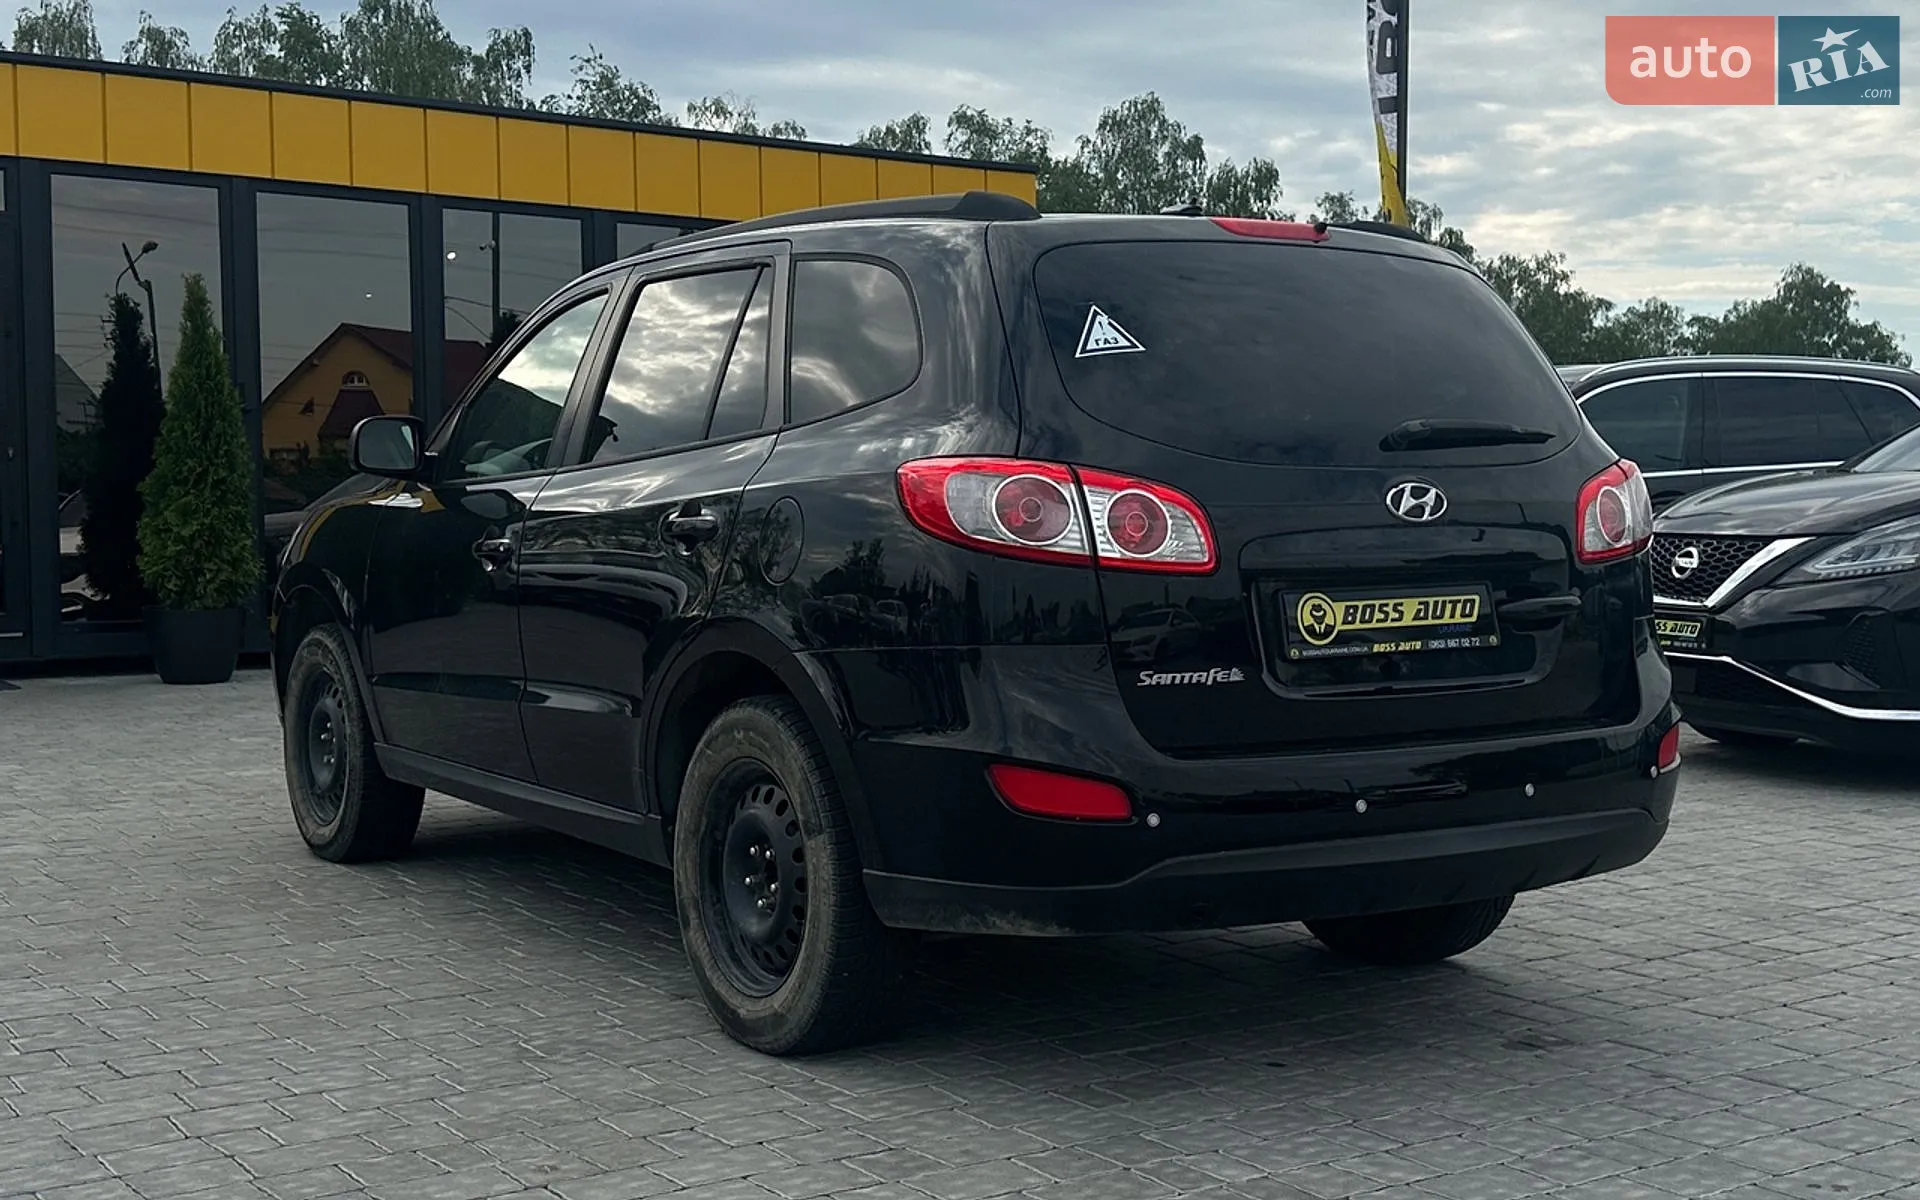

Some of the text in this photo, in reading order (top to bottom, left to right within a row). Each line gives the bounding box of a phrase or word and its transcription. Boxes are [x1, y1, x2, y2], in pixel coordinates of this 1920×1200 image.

[1094, 337, 1119, 346] ГАЗ
[1341, 598, 1477, 625] BOSS AUTO
[1669, 622, 1698, 635] AUTO
[1372, 642, 1396, 653] BOSS
[1398, 640, 1422, 650] AUTO
